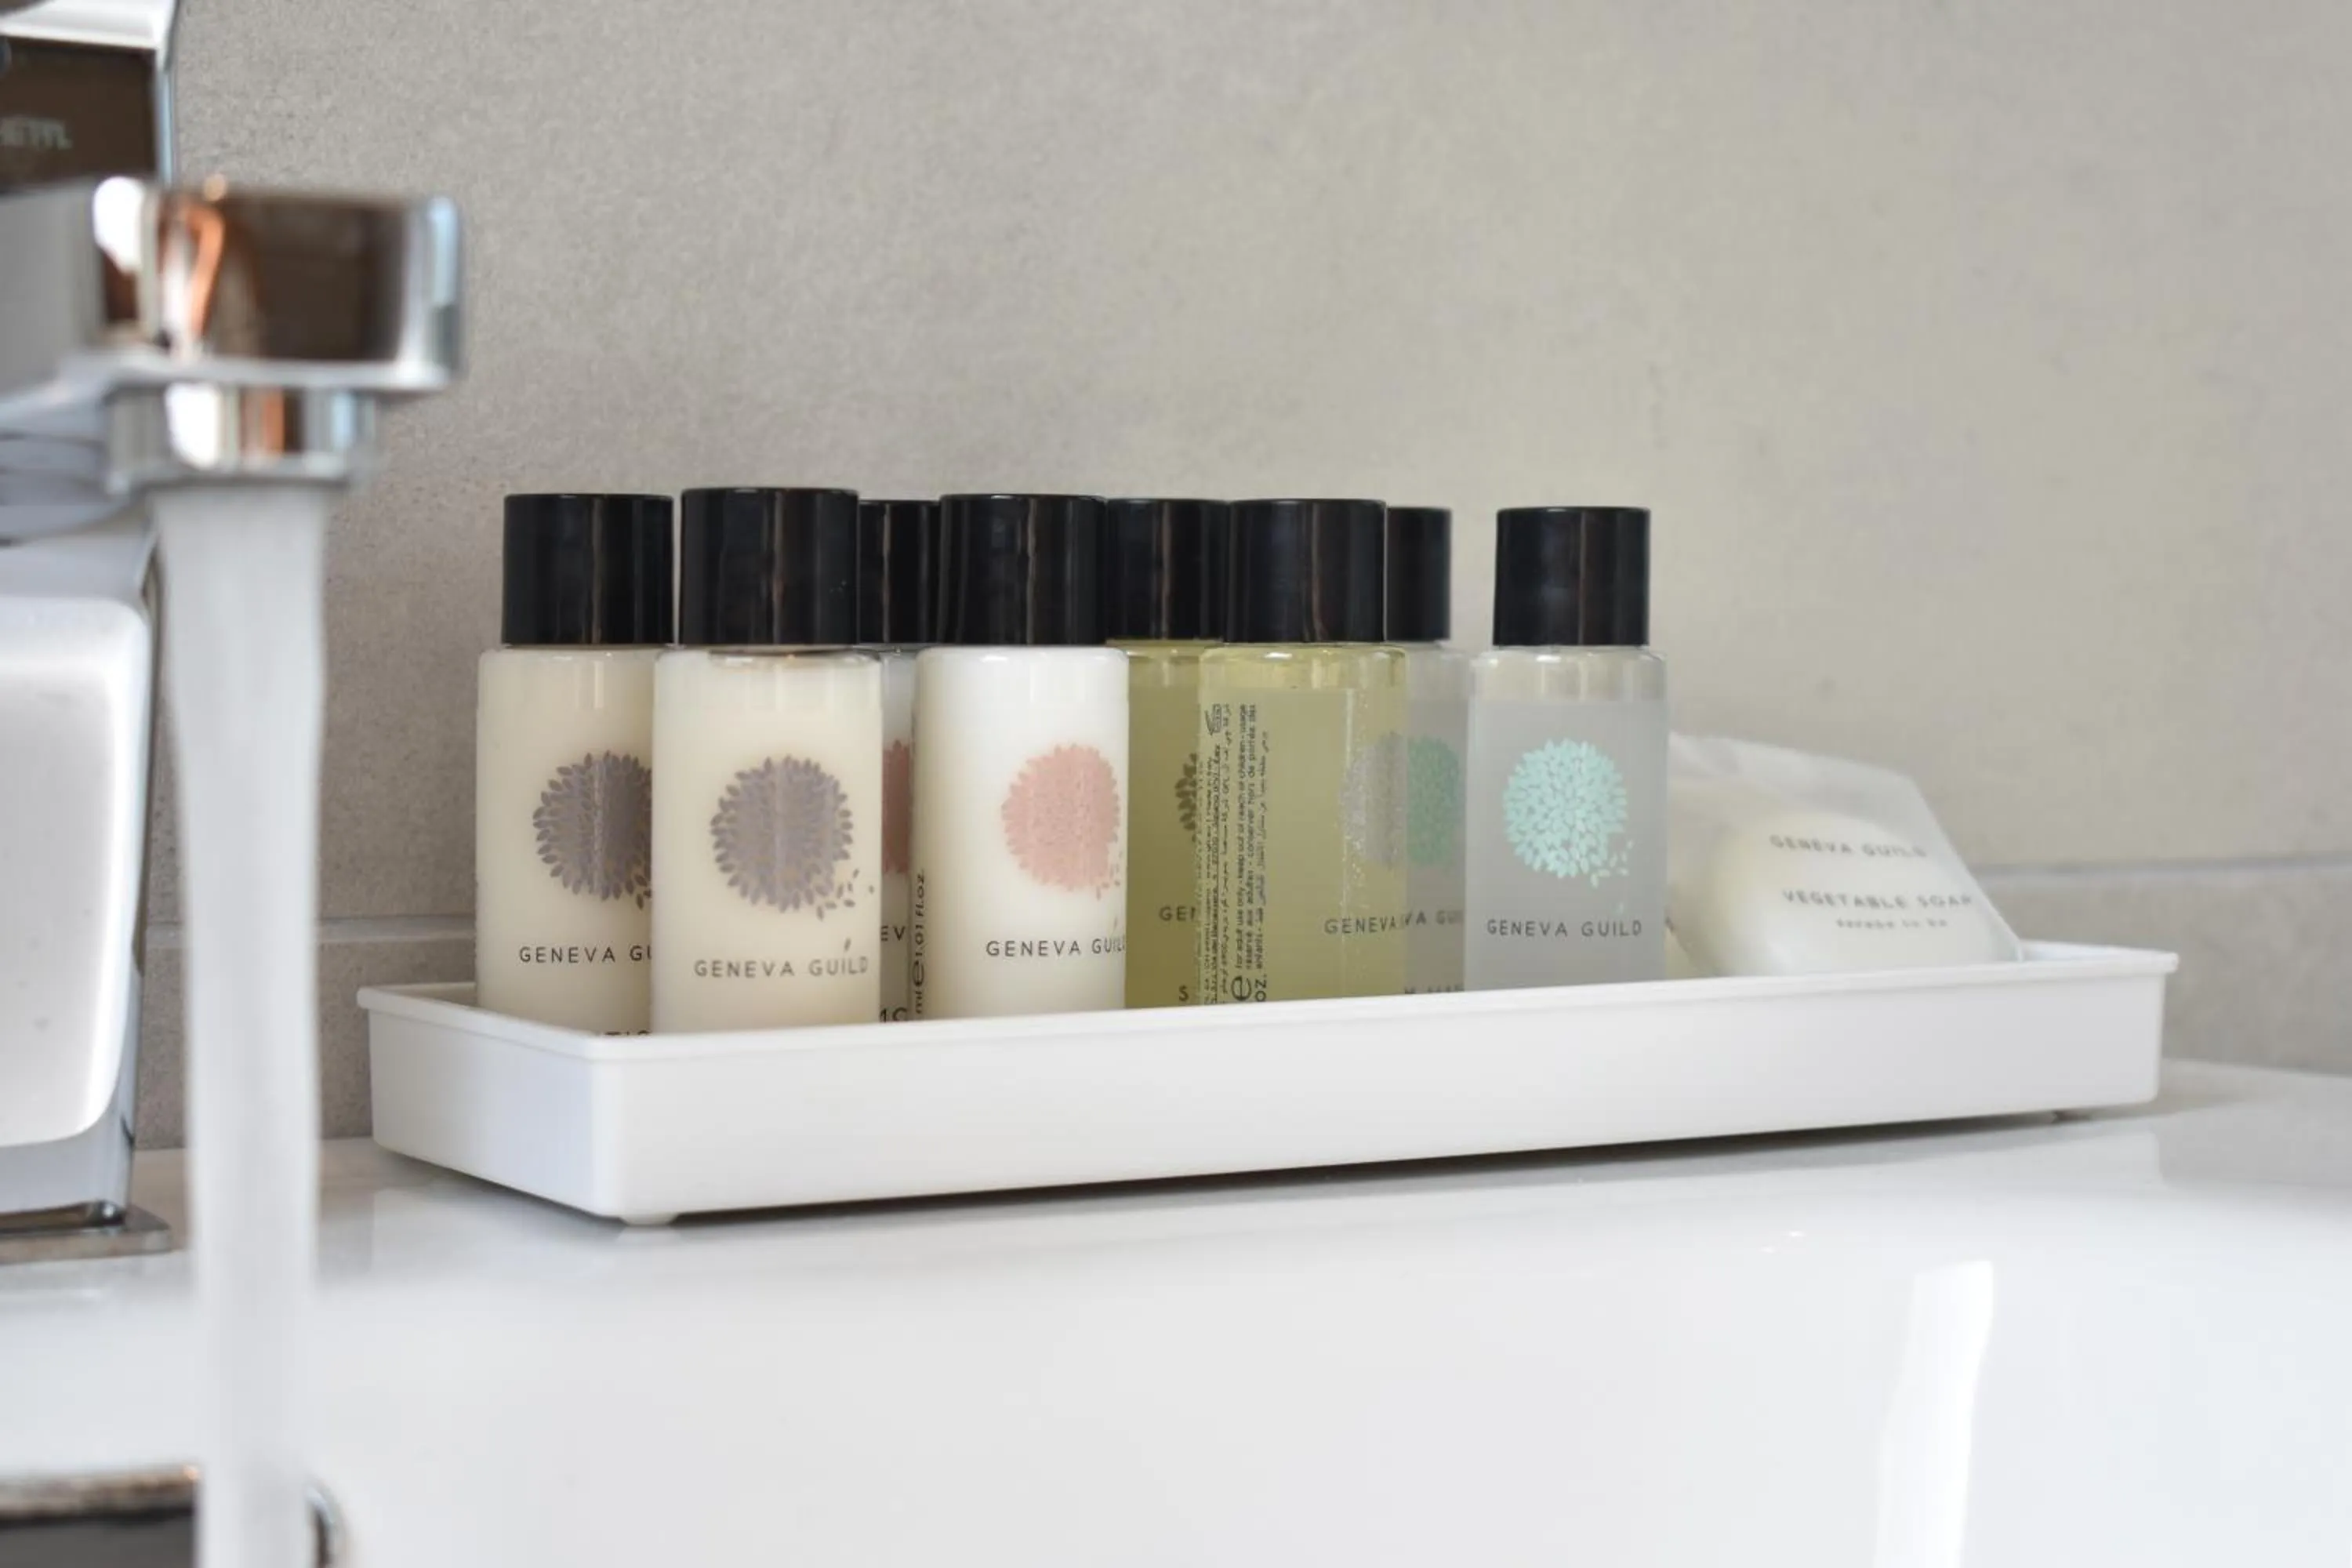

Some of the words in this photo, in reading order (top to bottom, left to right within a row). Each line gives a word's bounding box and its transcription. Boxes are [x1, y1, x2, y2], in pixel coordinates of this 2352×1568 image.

[1782, 890, 1908, 909] VEGETABLE
[1917, 895, 1972, 909] SOAP
[1324, 916, 1396, 934] GENEVA
[1487, 919, 1568, 937] GENEVA
[1581, 920, 1642, 938] GUILD
[519, 946, 616, 963] GENEVA
[985, 940, 1081, 956] GENEVA
[694, 960, 795, 978] GENEVA
[808, 956, 869, 977] GUILD
